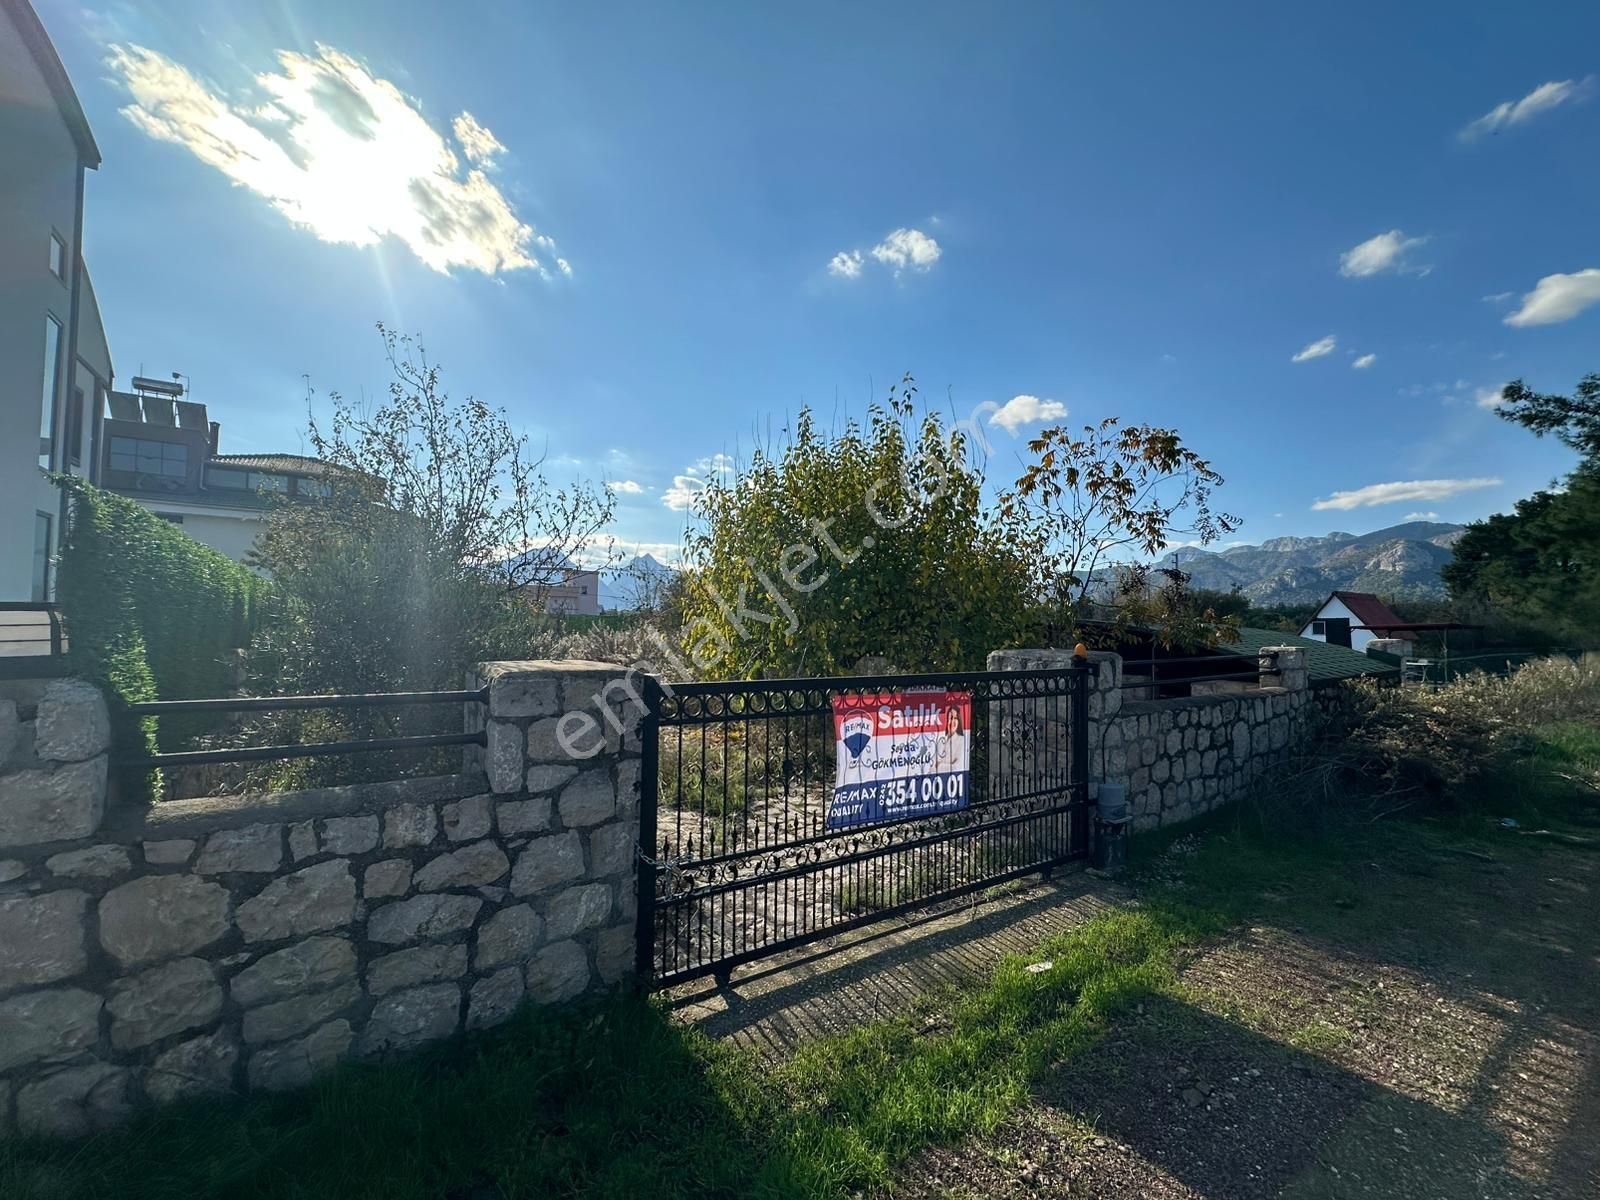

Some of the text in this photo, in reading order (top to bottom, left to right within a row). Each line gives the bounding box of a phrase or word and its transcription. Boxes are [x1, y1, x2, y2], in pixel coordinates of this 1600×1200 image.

[878, 703, 943, 729] Satılık
[845, 722, 870, 733] RE/MAX
[833, 787, 878, 804] RE/MAX
[886, 773, 964, 806] 354 00 01
[831, 803, 864, 817] QUALITY
